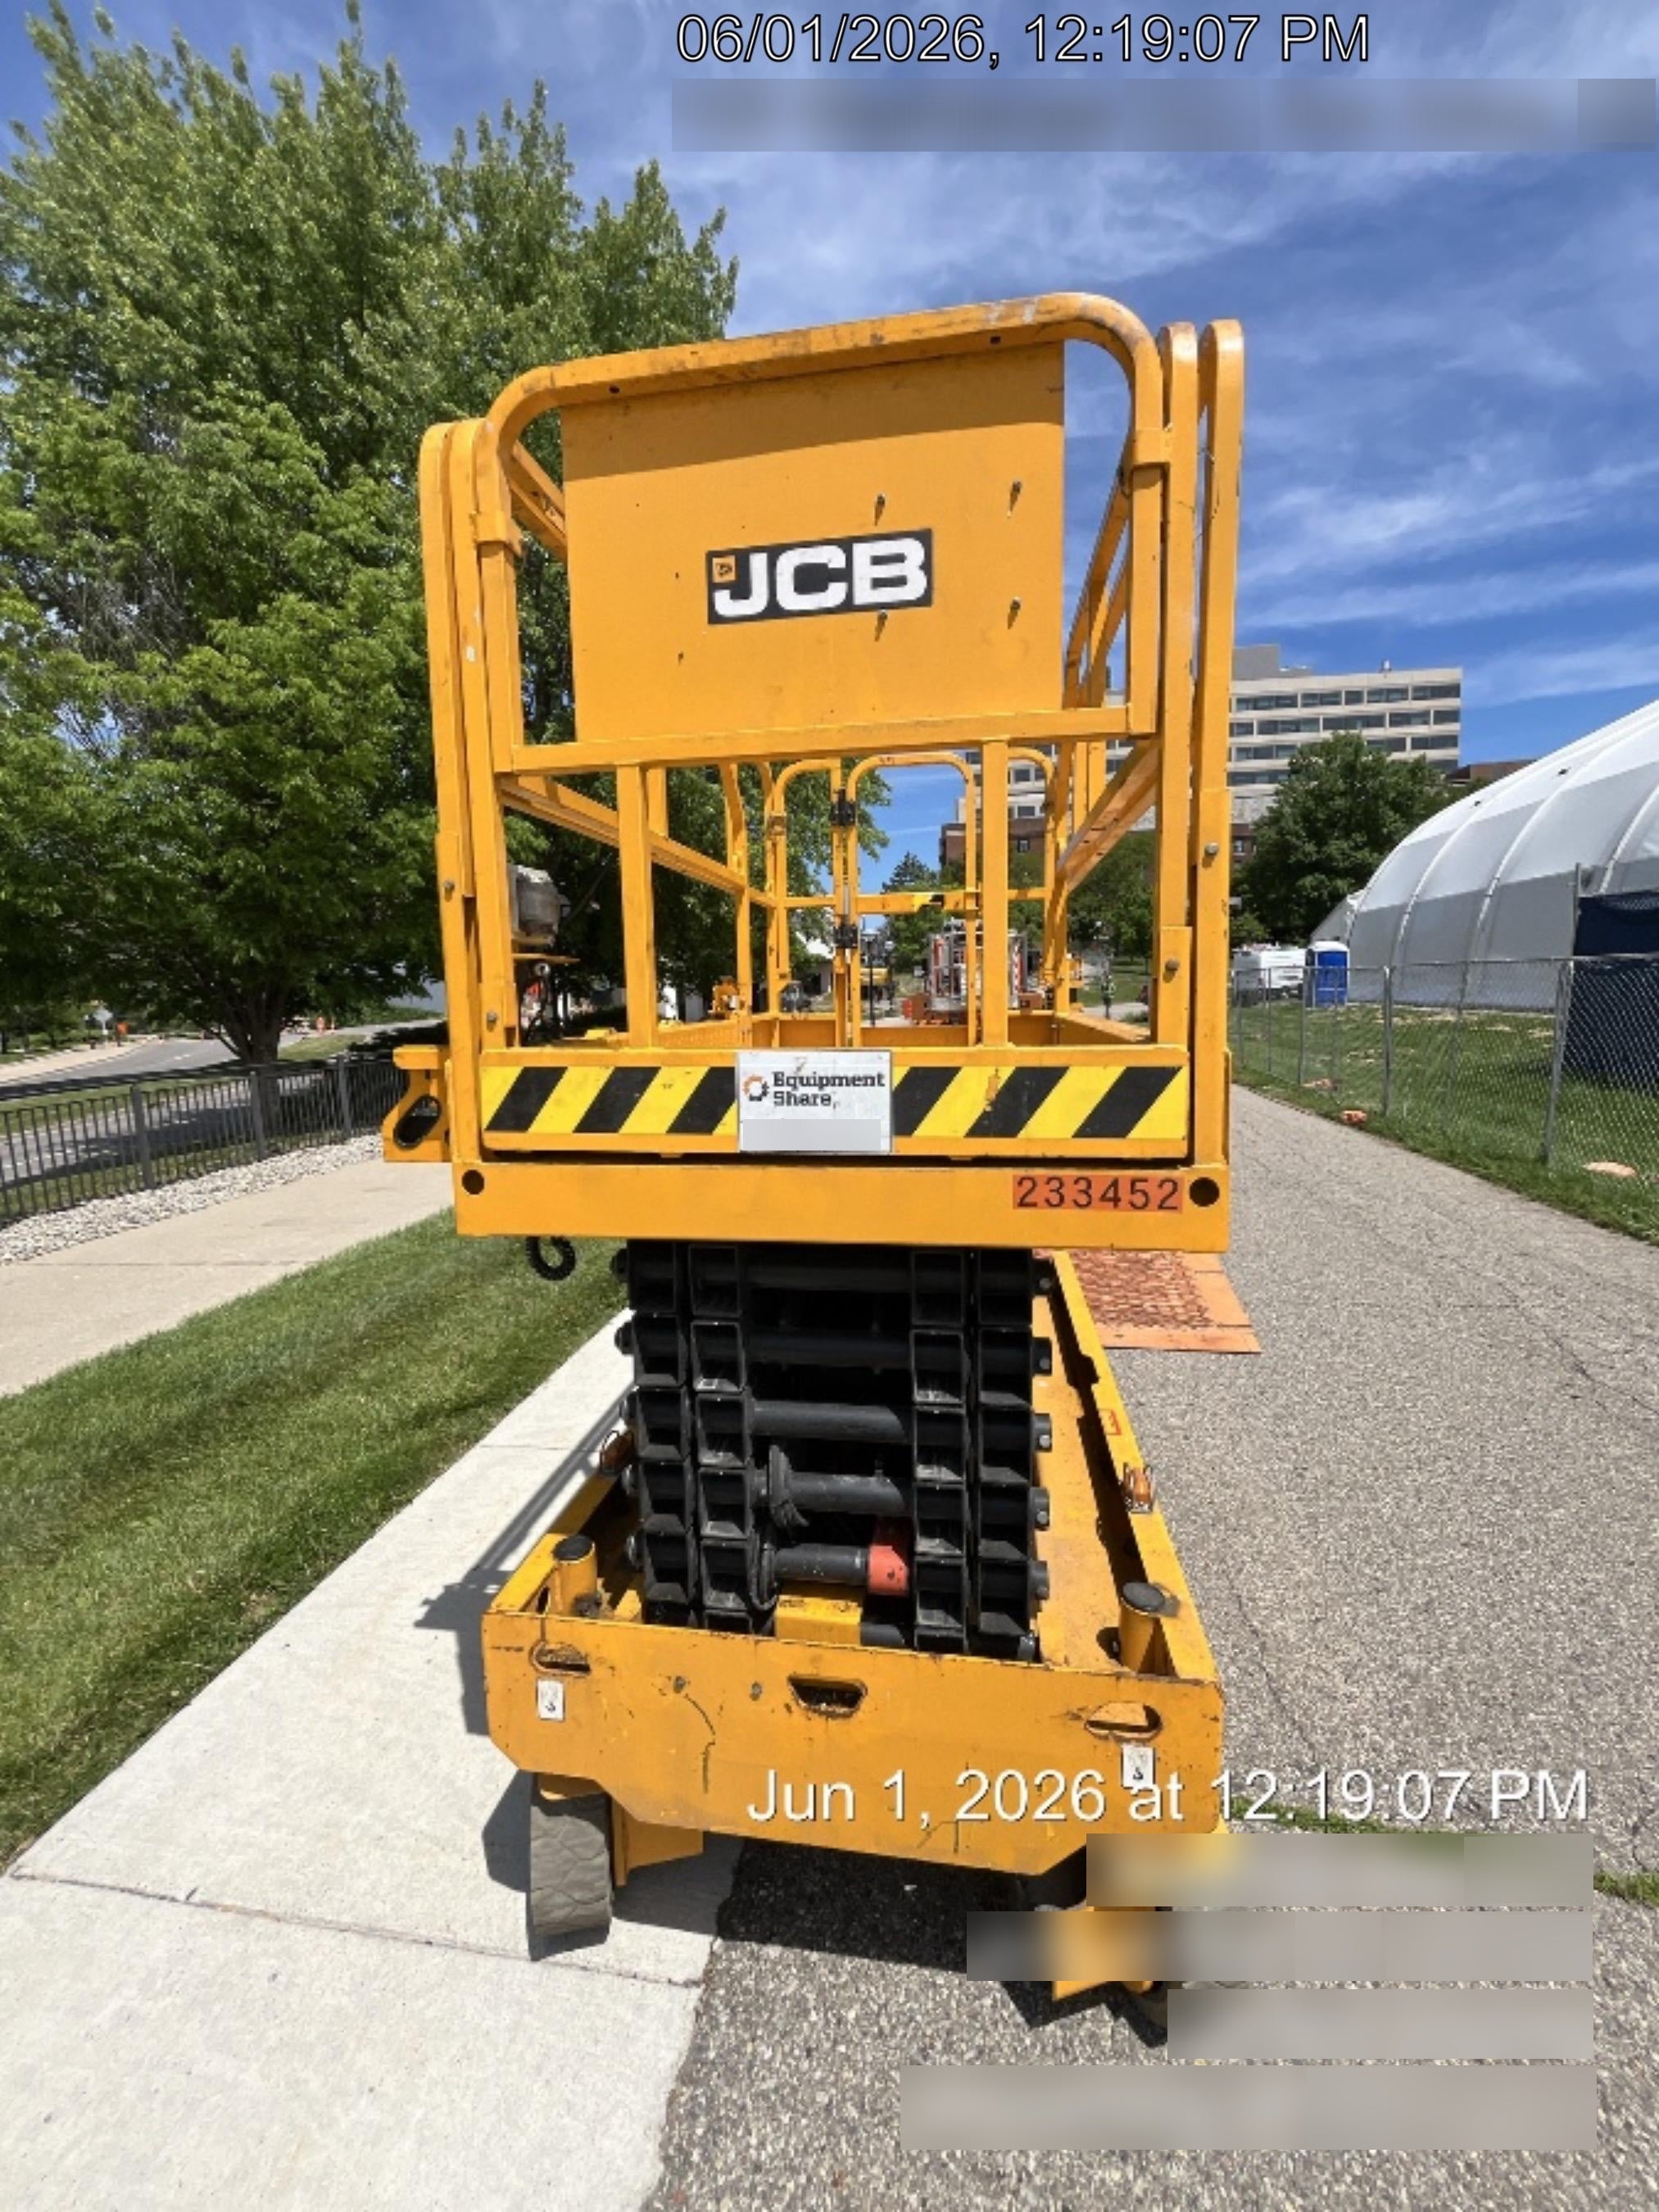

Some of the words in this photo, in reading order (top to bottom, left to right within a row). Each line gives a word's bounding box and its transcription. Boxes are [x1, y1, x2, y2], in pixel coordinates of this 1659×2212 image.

[714, 537, 927, 617] JCB
[773, 1072, 886, 1091] Equipment
[773, 1091, 832, 1106] Share
[1017, 1176, 1180, 1211] 233452
